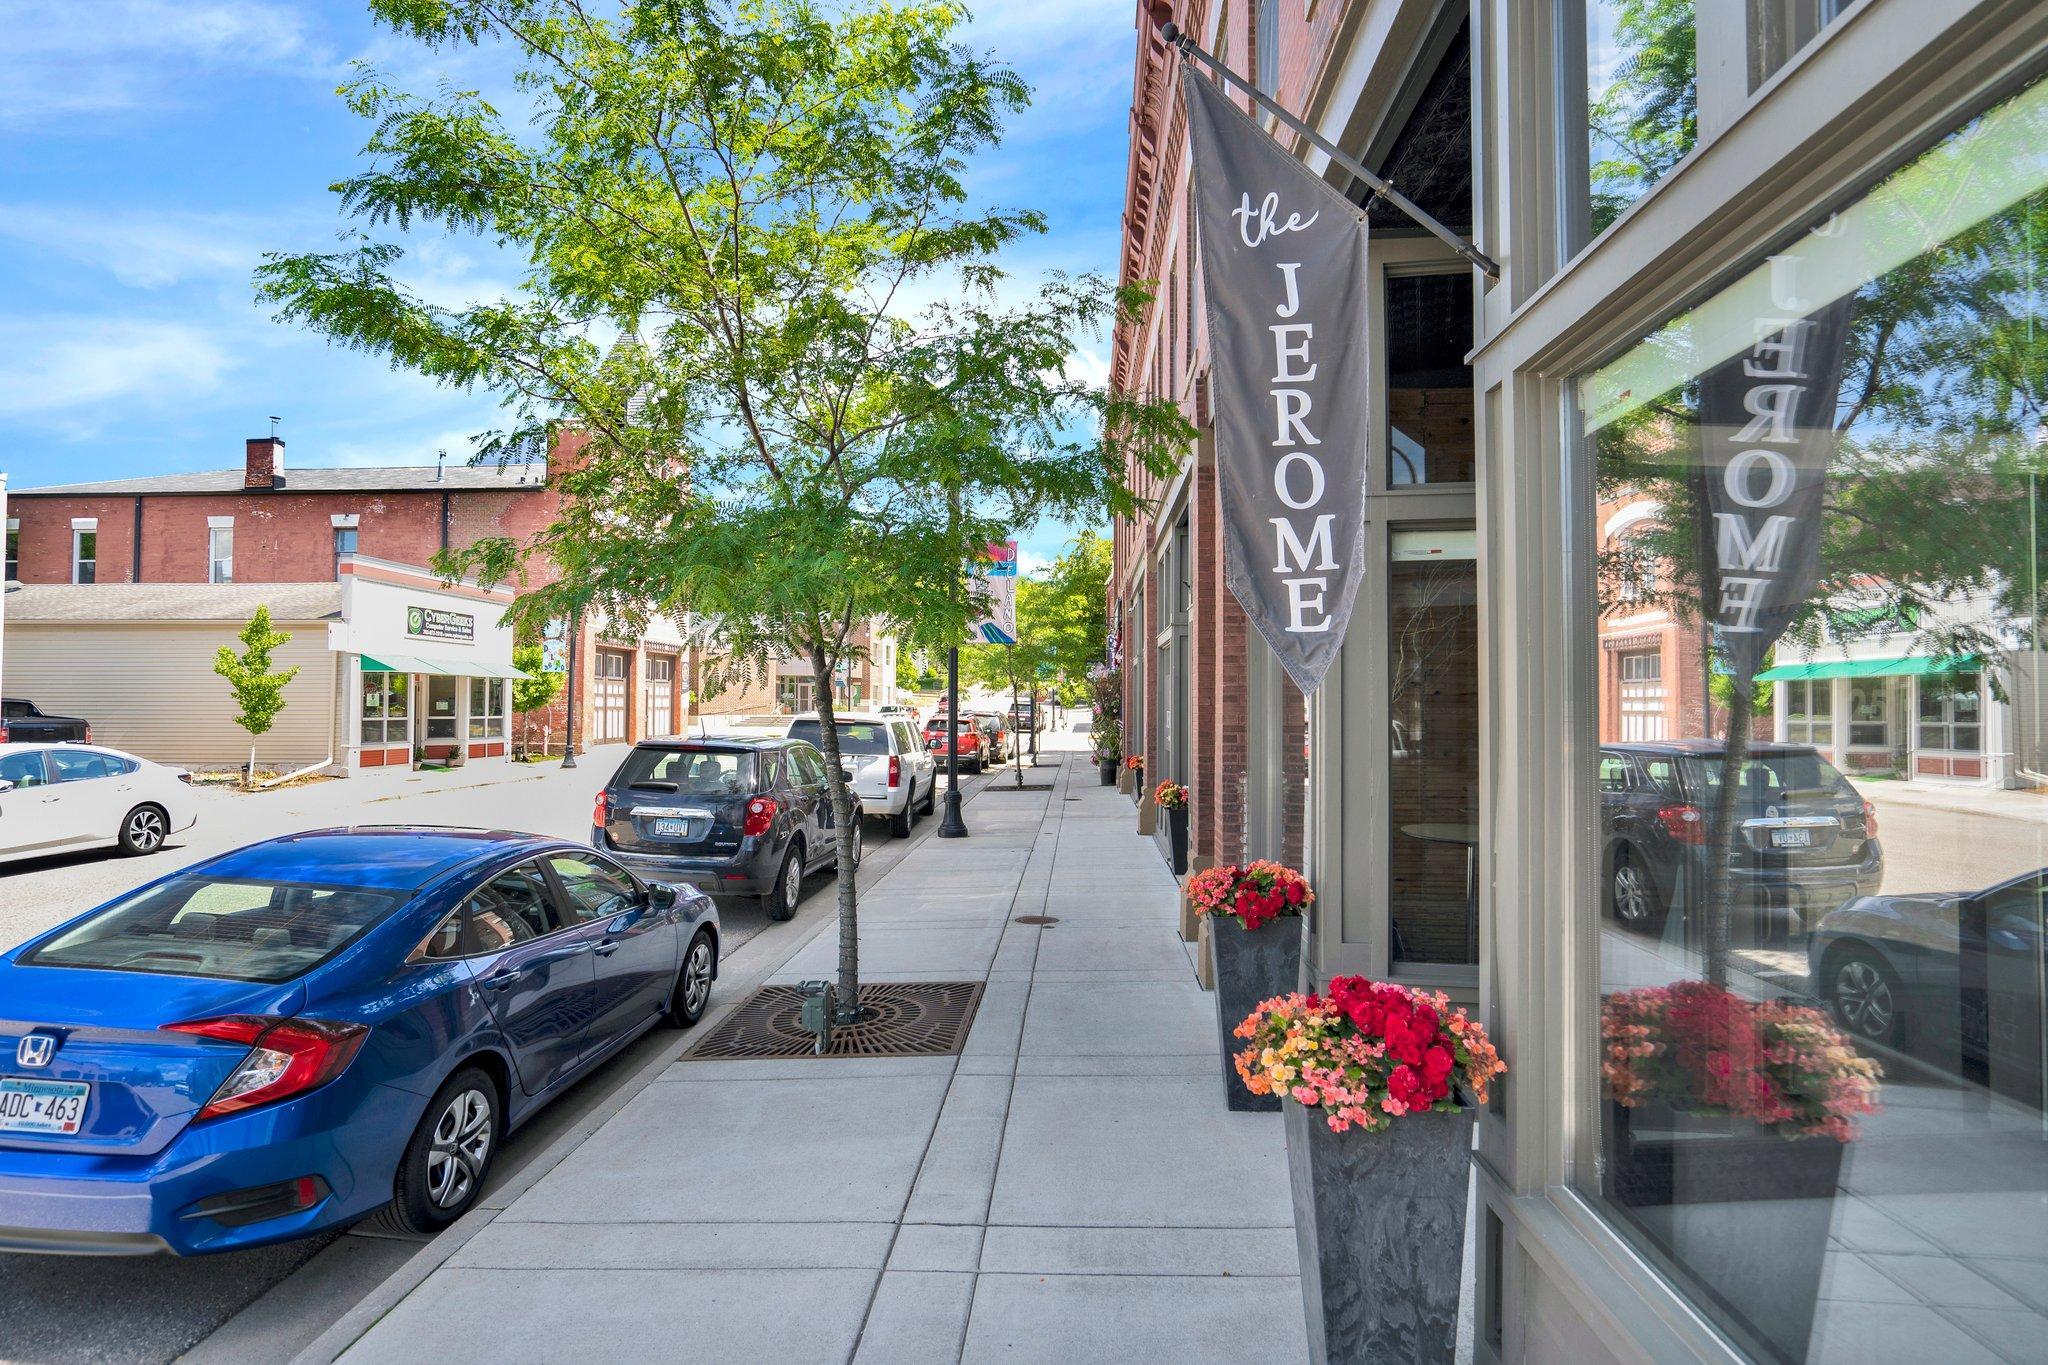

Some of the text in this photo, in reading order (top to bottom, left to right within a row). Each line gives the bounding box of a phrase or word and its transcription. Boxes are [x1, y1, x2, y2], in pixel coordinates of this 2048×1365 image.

[1232, 192, 1319, 247] the
[1269, 262, 1340, 633] JEROME
[1003, 547, 1015, 634] DELANO
[0, 1093, 80, 1121] ADC 463
[23, 1082, 64, 1096] Minnesota
